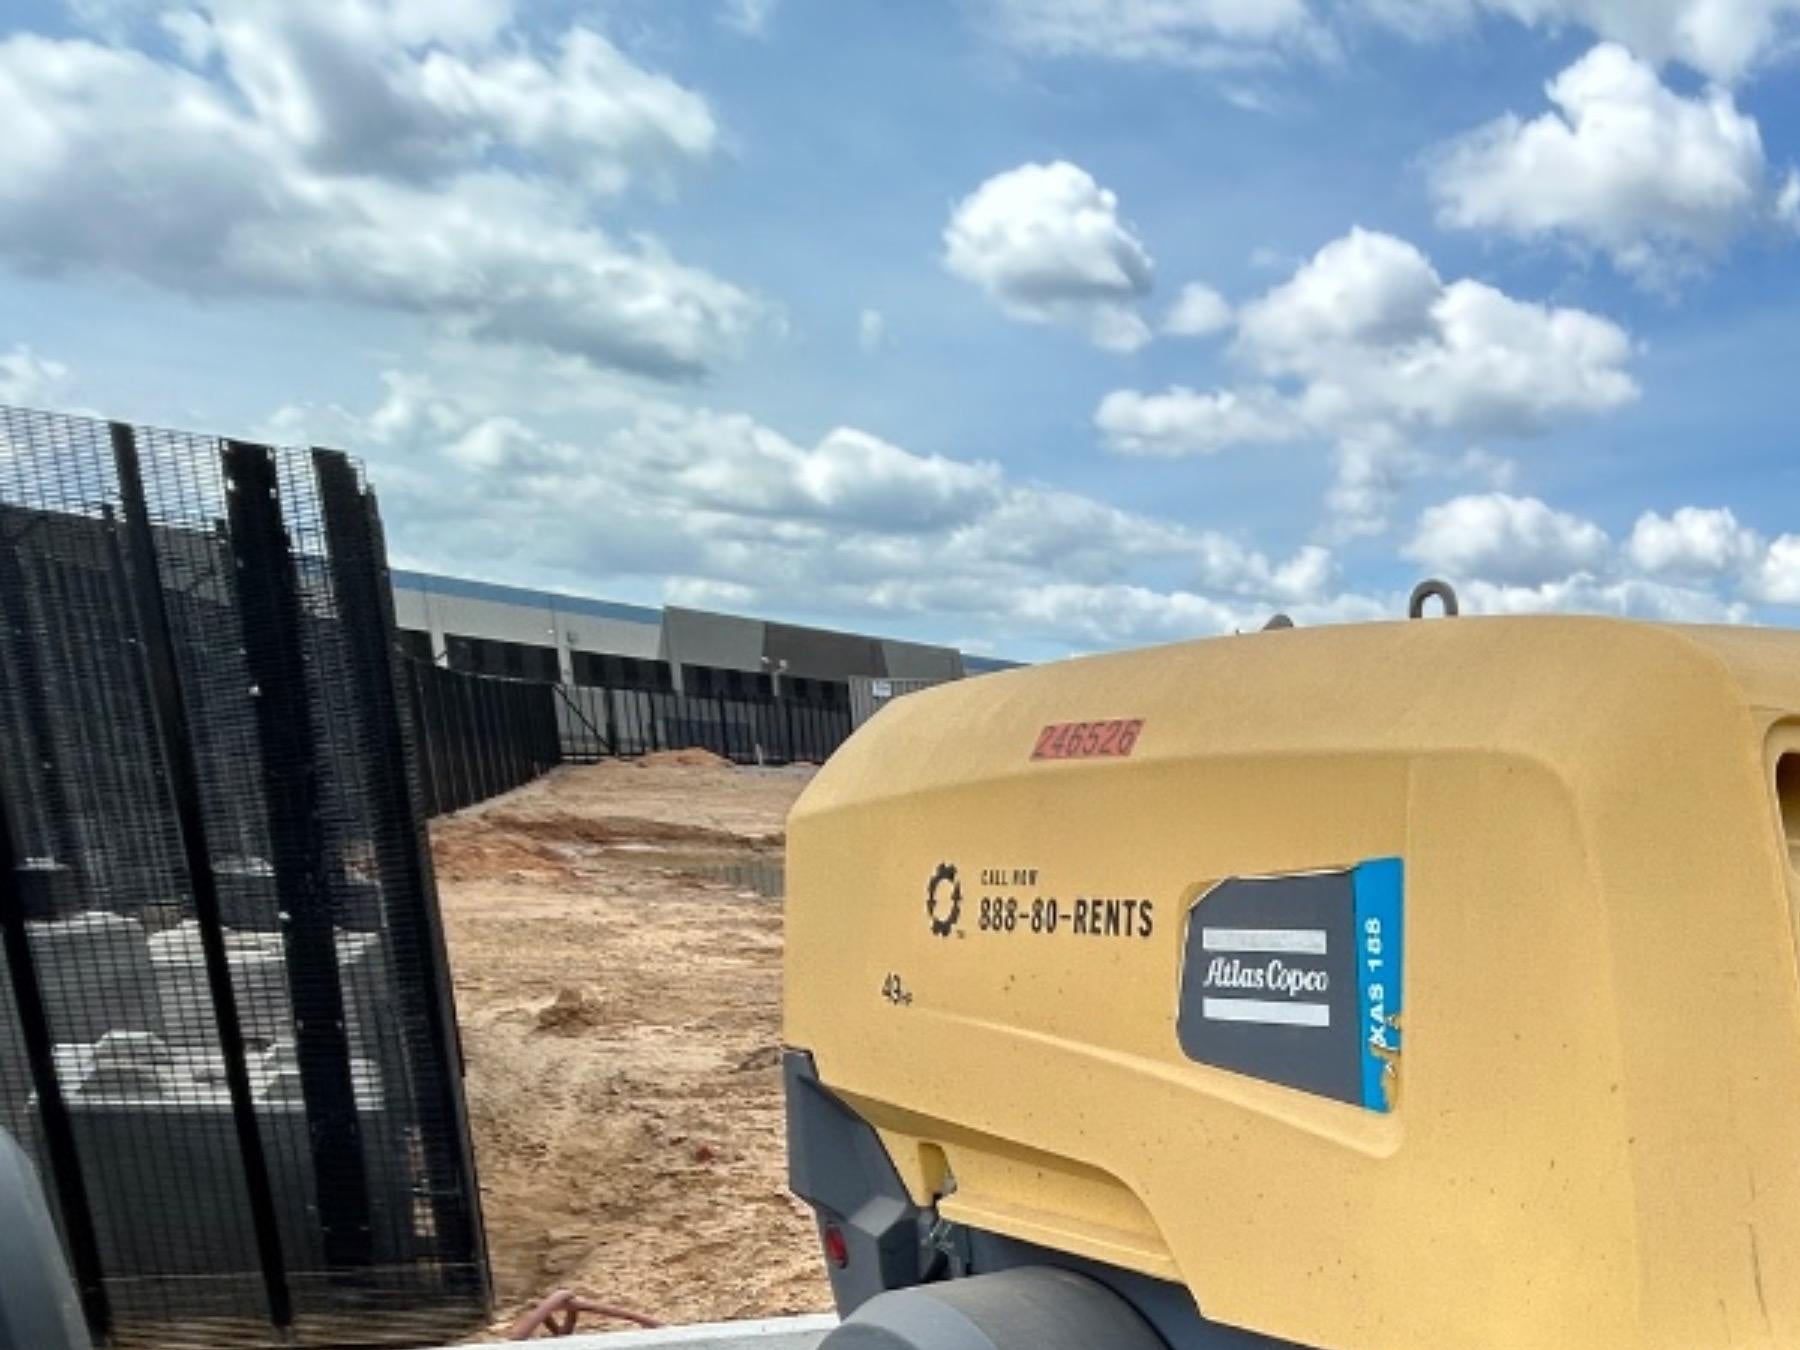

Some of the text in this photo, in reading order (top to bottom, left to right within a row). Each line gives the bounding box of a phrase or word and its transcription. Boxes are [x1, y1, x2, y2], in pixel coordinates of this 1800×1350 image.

[1031, 719, 1144, 757] 246526
[980, 869, 1008, 886] CALL
[978, 897, 1153, 937] 888-80-RENTS
[1203, 957, 1328, 996] Atlas Copco
[1369, 983, 1386, 1047] XAS
